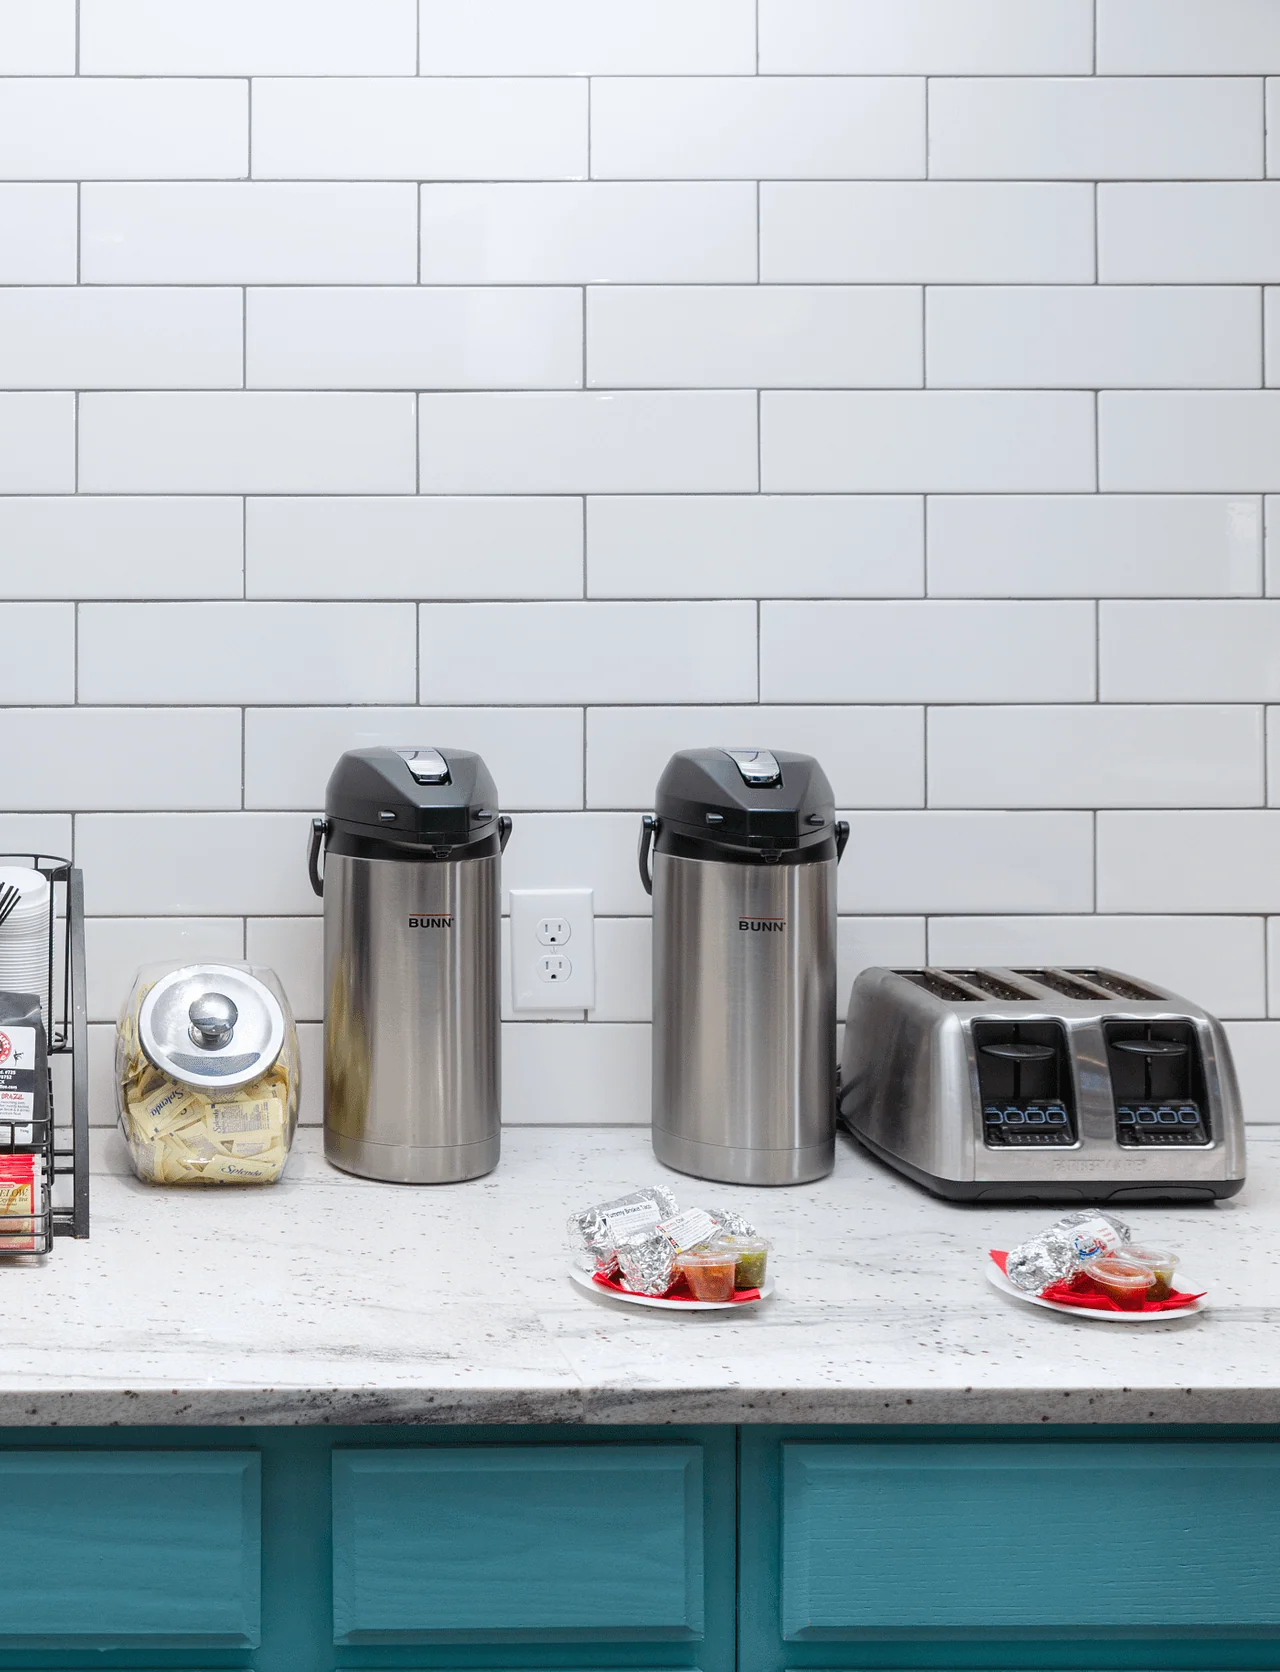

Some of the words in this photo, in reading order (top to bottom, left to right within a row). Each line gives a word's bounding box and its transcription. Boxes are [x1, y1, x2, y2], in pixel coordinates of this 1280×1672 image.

[408, 918, 452, 928] BUNN
[739, 921, 784, 932] BUNN
[151, 1088, 184, 1116] Splenda
[213, 1109, 221, 1133] Splenda
[221, 1164, 264, 1177] Splenda
[606, 1210, 624, 1219] Yummy
